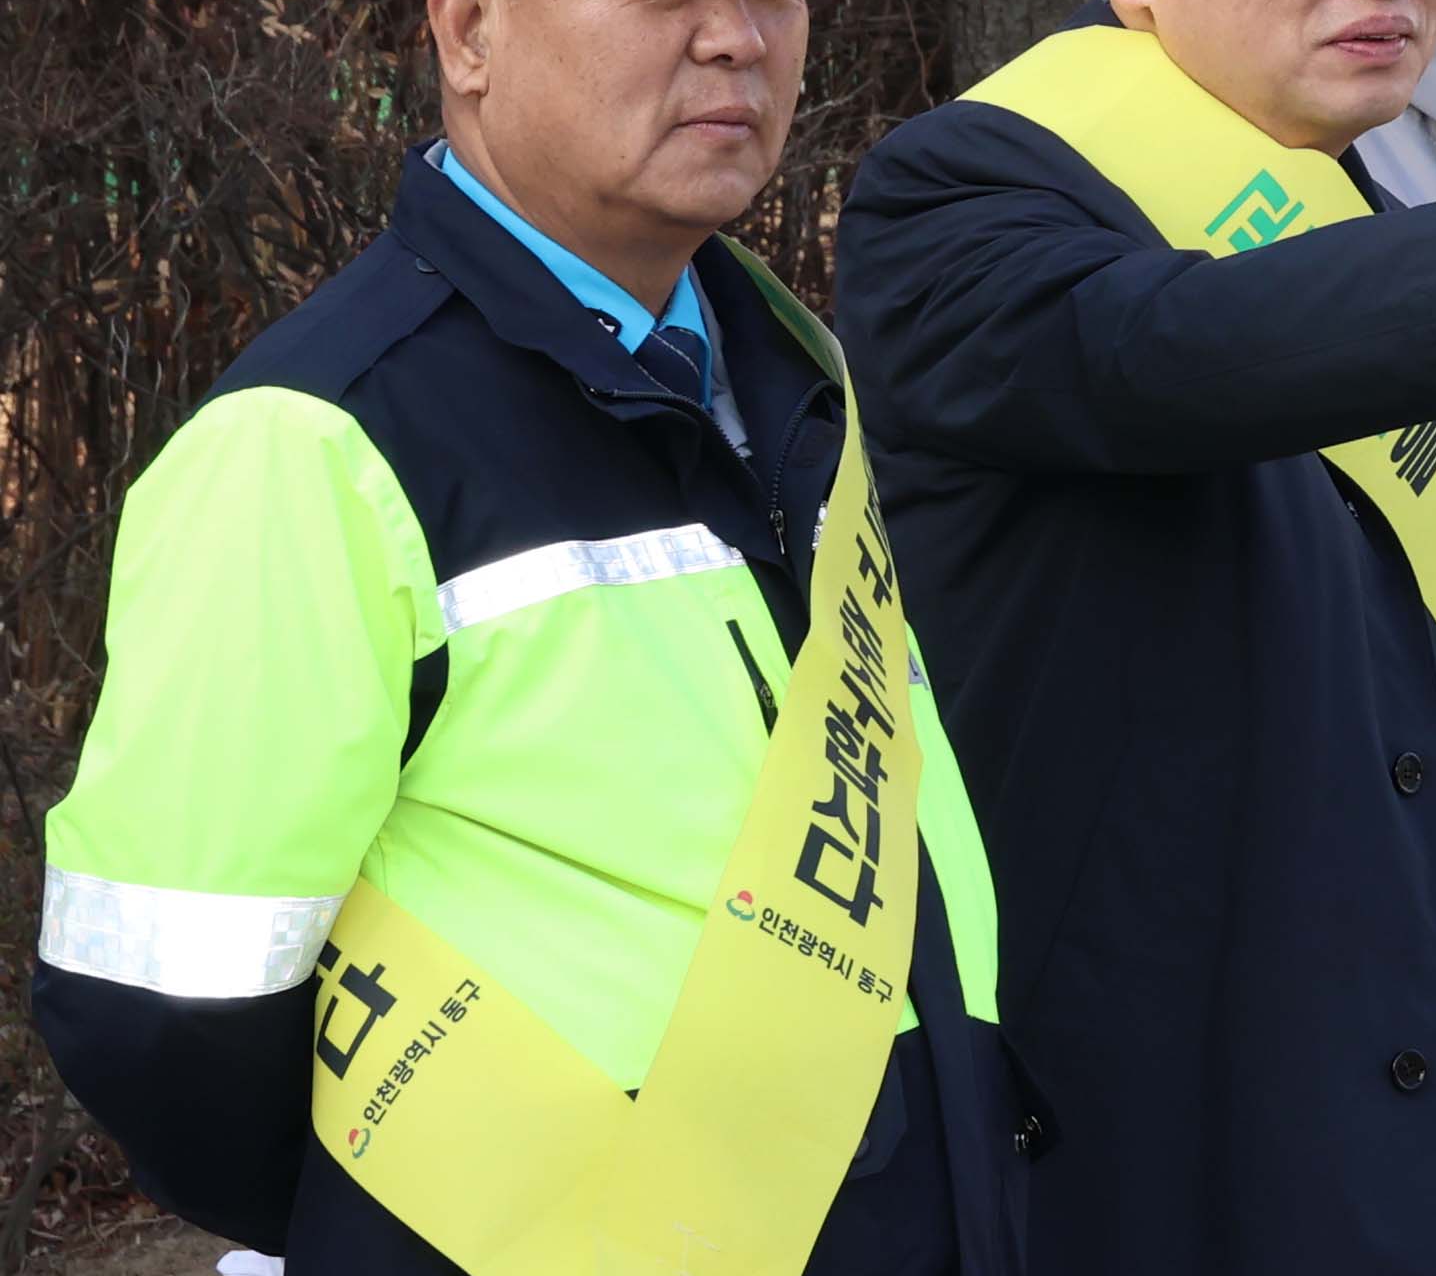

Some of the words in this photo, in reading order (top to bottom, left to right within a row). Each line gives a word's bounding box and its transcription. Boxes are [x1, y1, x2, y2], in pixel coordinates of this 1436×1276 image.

[793, 584, 897, 929] 준수합시다
[758, 906, 855, 980] 인천광역시
[856, 967, 895, 1004] 동구
[363, 1020, 448, 1126] 인천광역시
[439, 978, 482, 1023] 동구
